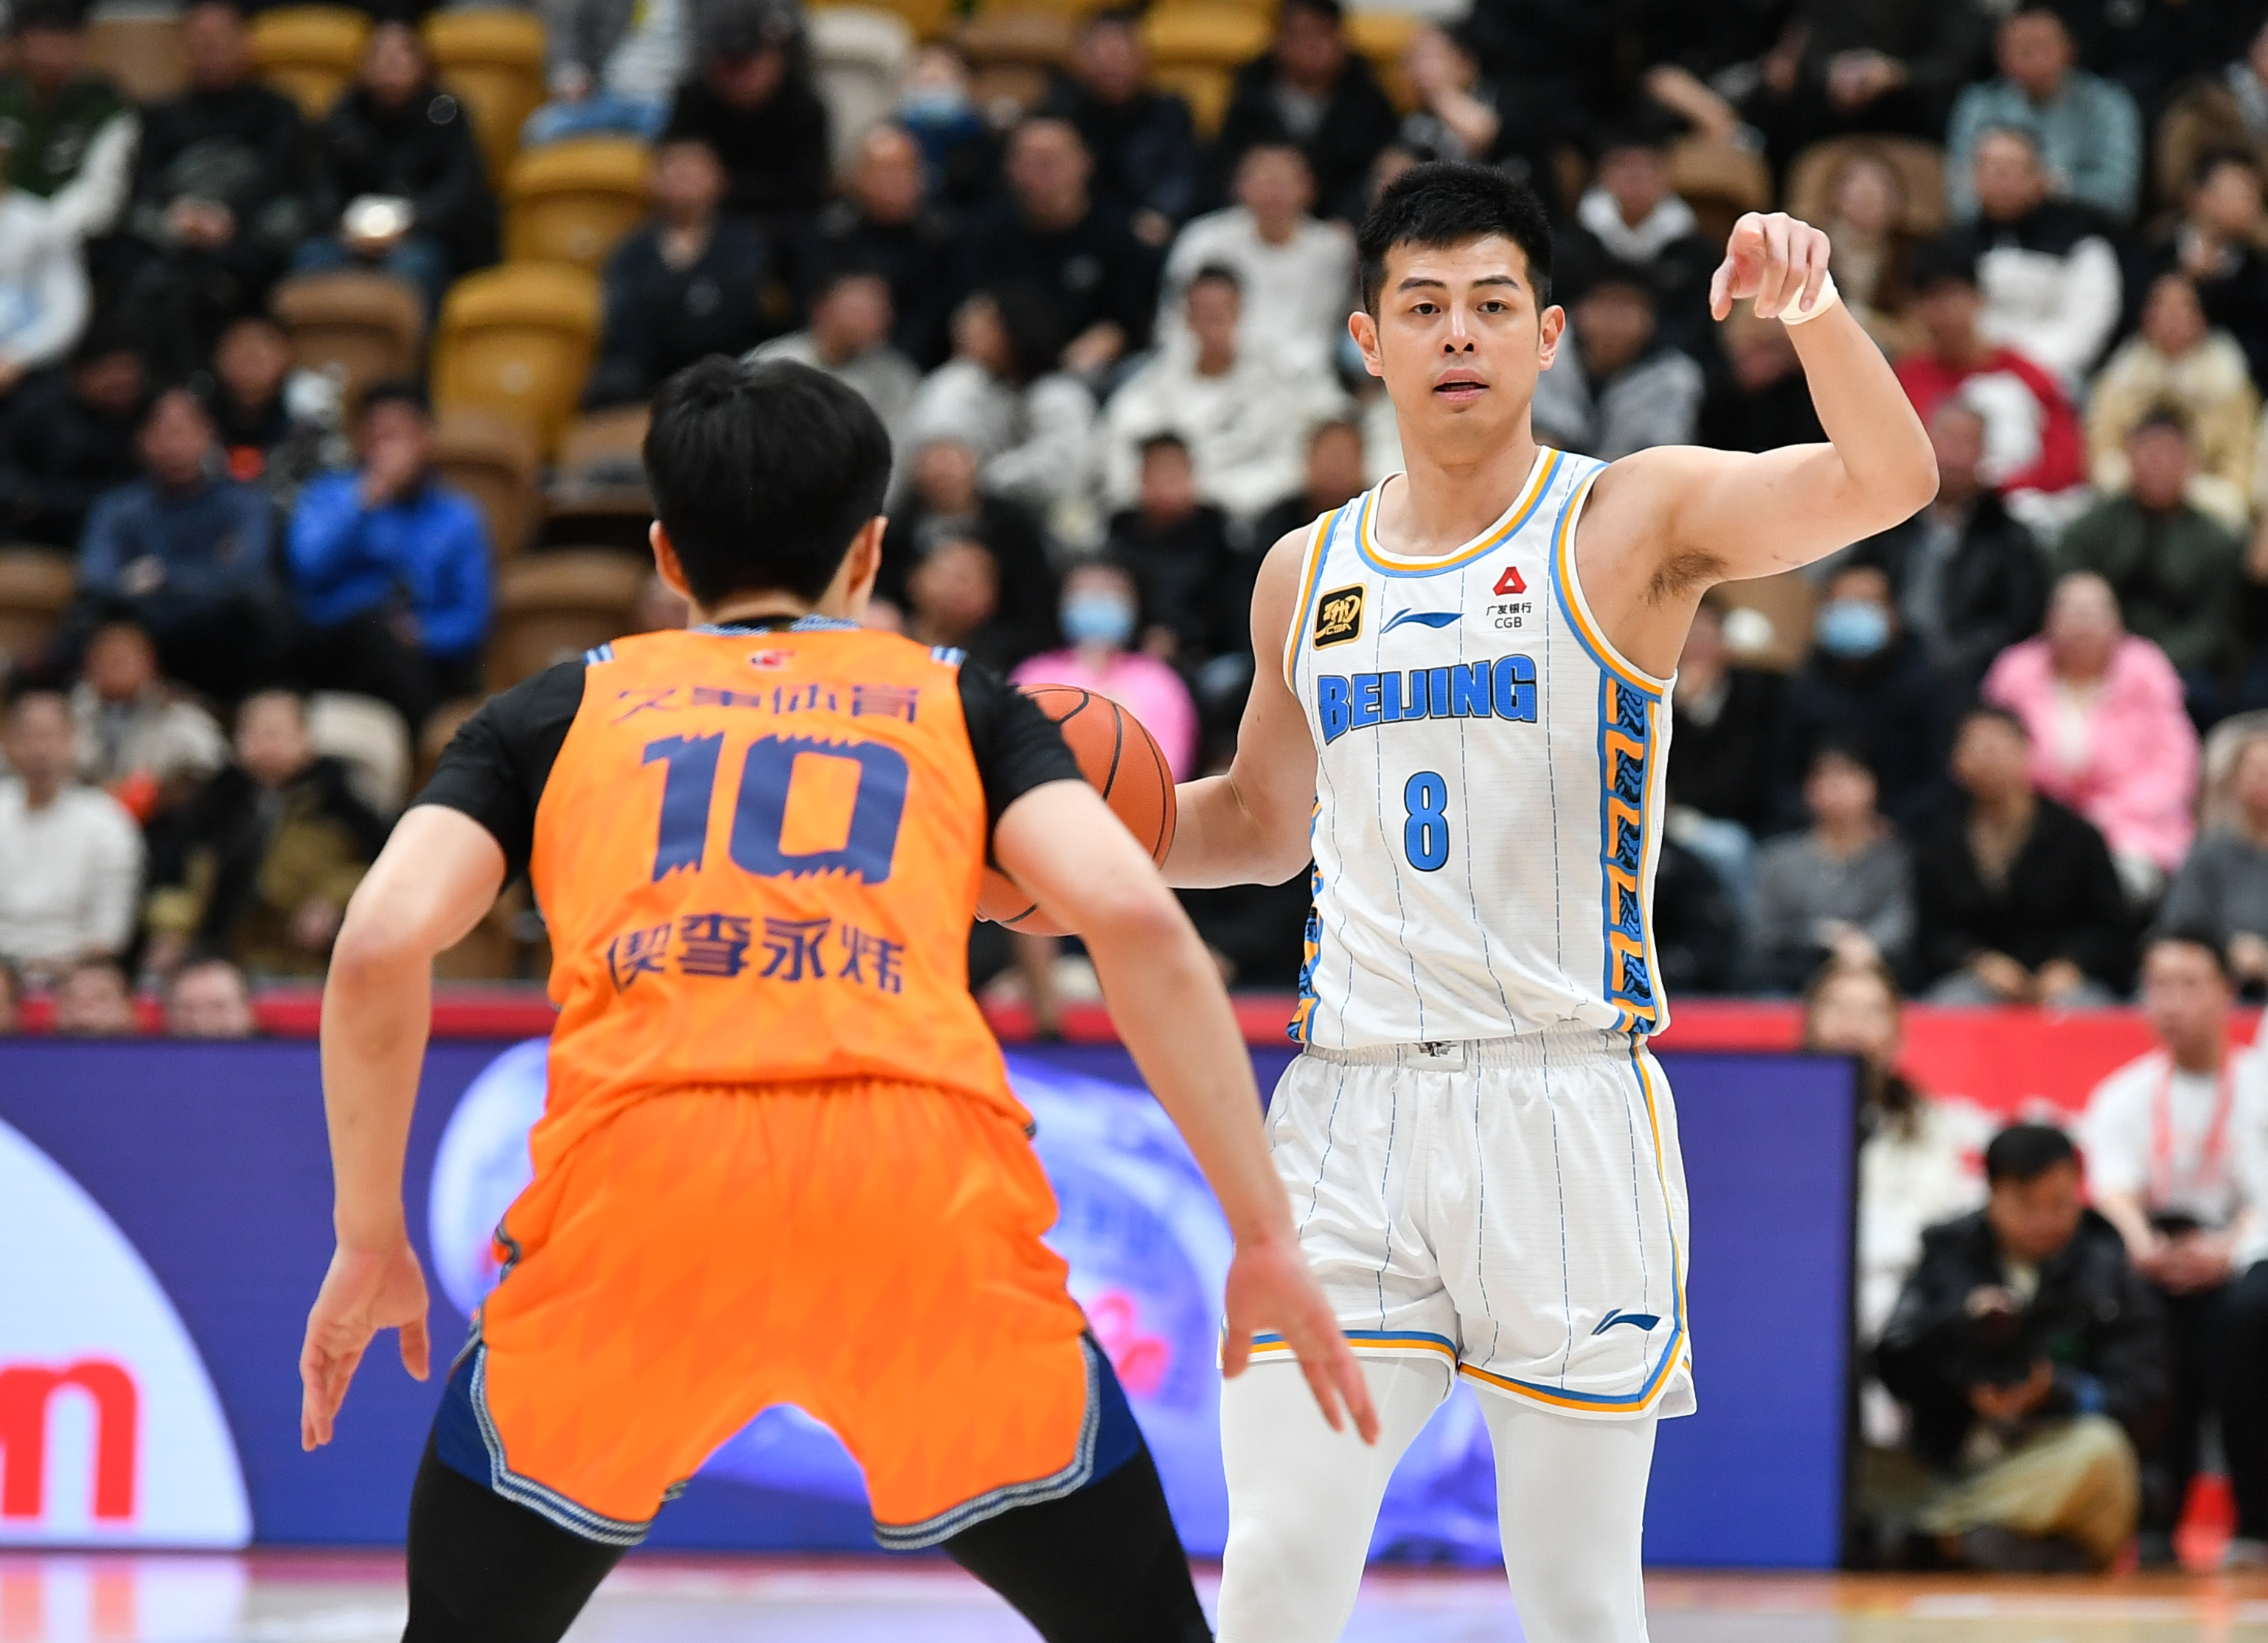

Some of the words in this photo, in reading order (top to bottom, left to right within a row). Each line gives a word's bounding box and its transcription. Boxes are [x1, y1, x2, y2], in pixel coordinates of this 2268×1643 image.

[1486, 602, 1532, 616] 广发银行
[1494, 616, 1523, 629] CGB
[1318, 654, 1537, 746] BEIJING
[642, 731, 909, 885] 10
[1403, 771, 1450, 872] 8
